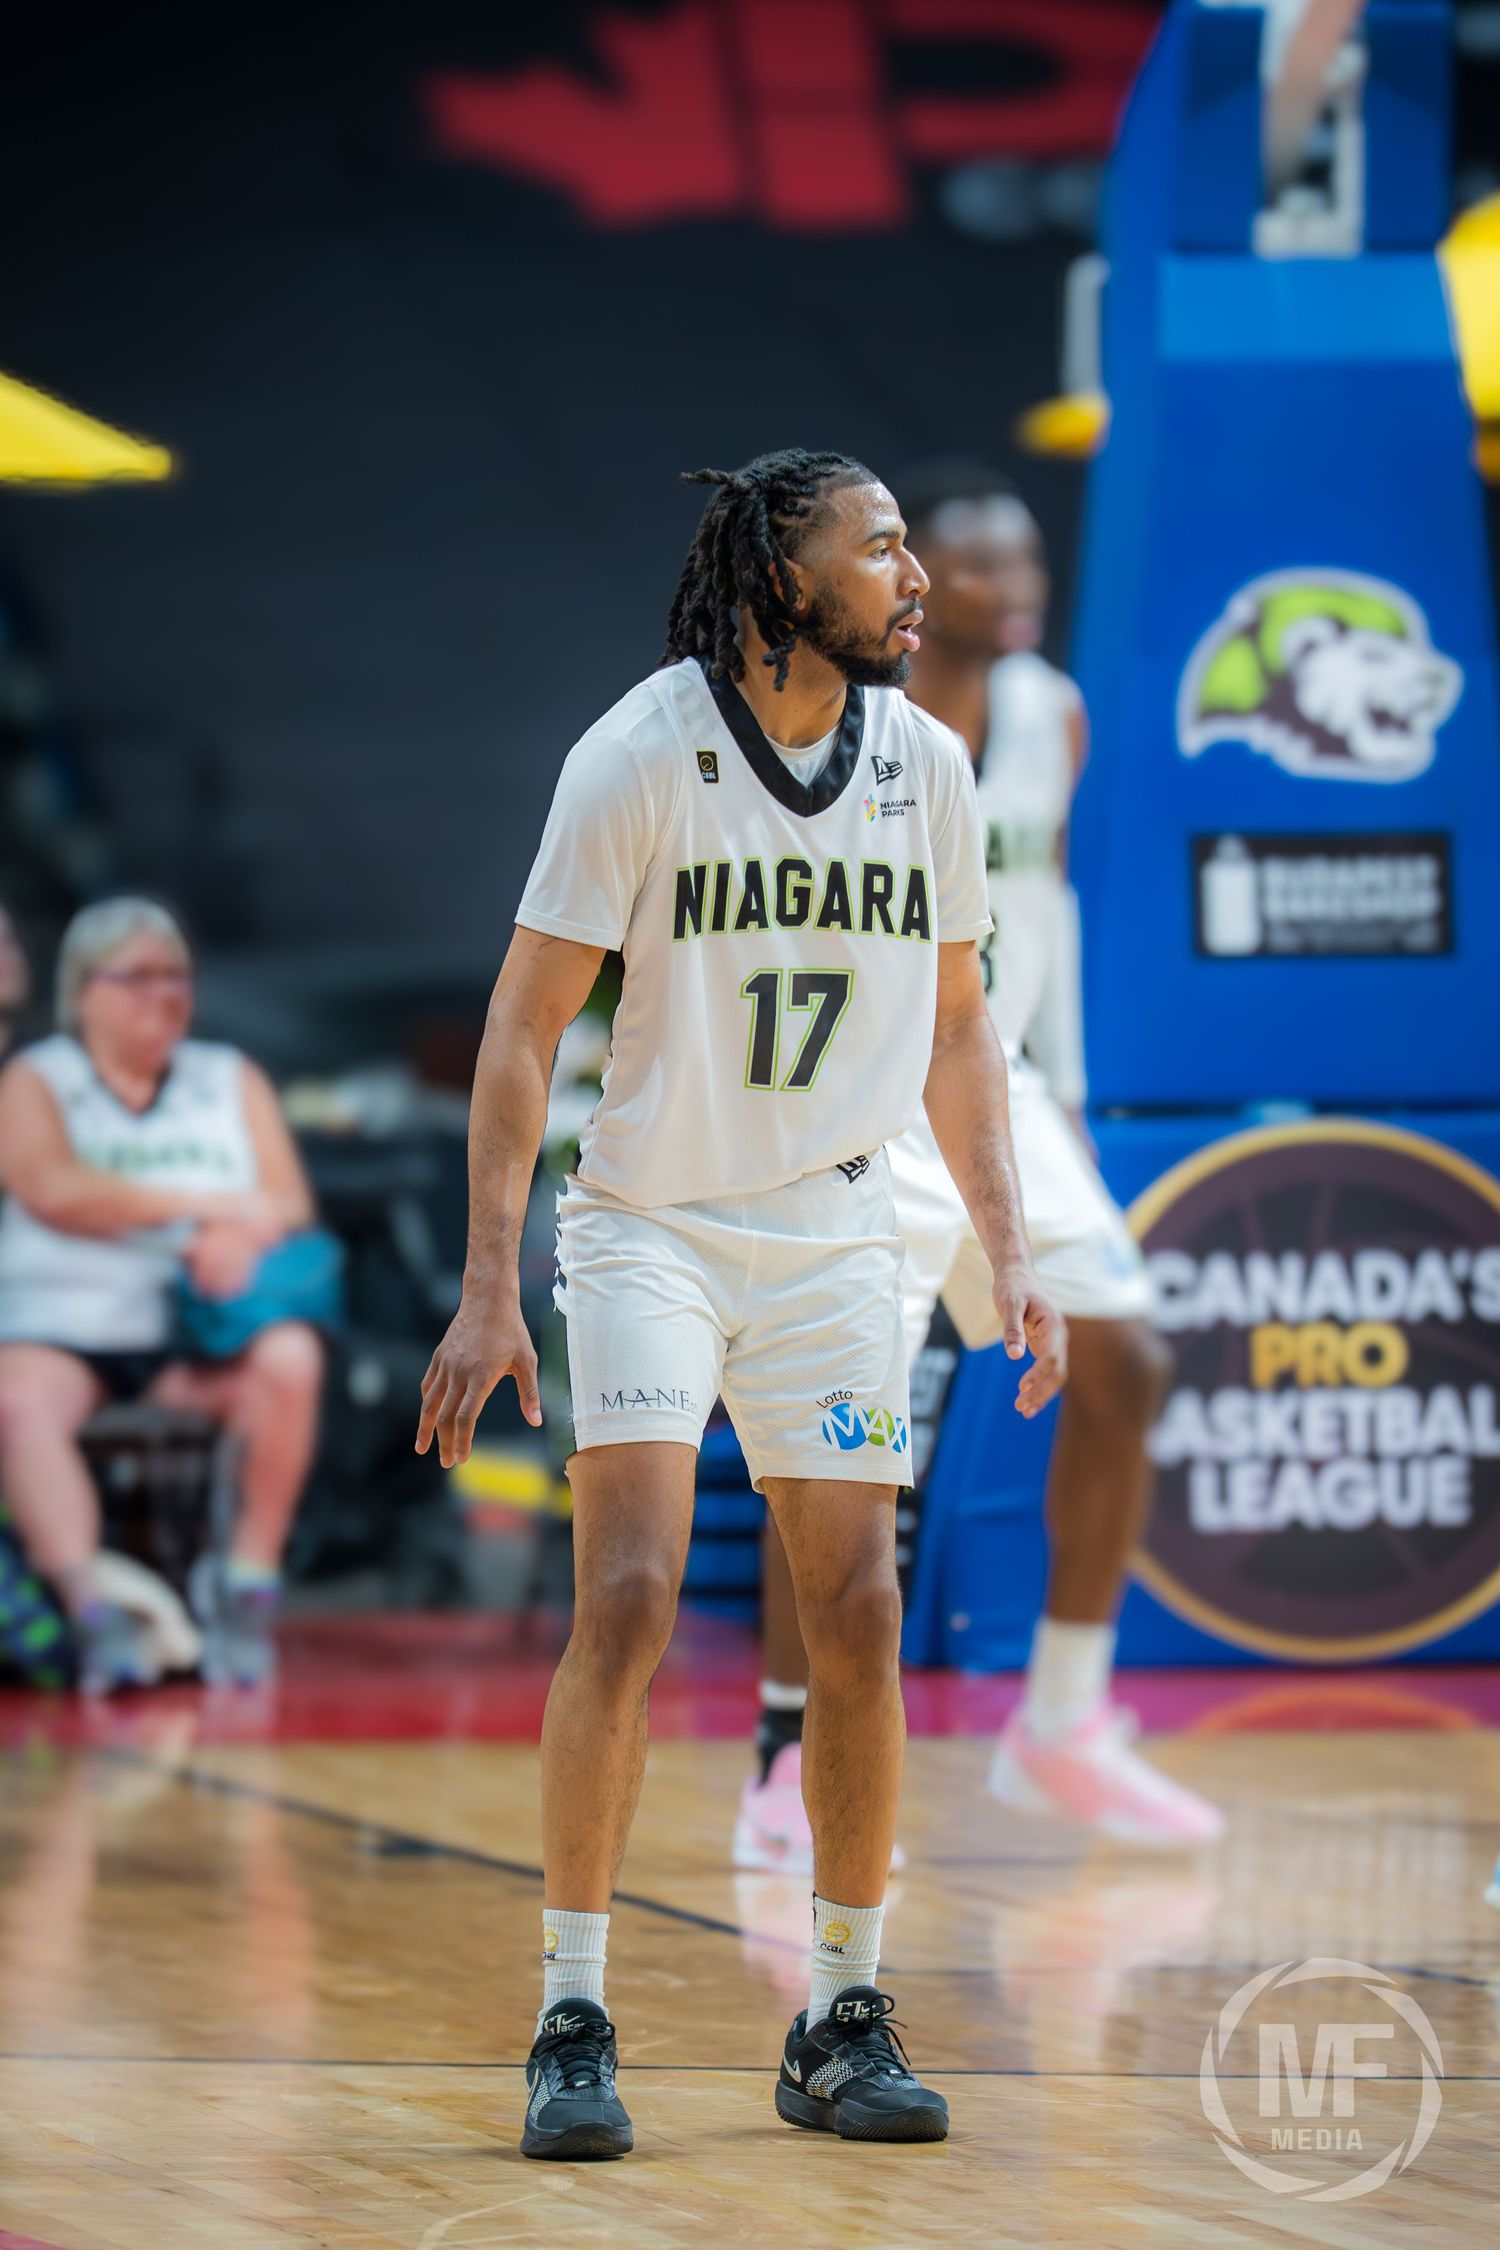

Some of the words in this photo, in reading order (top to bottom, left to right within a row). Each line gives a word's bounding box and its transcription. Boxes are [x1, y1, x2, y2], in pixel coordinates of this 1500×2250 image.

[880, 798, 917, 810] NIAGARA
[881, 808, 906, 819] PARKS
[672, 855, 933, 944] NIAGARA
[740, 968, 855, 1092] 17
[1250, 1322, 1410, 1388] PRO
[601, 1387, 690, 1412] MANE
[816, 1390, 854, 1409] Lotto
[822, 1402, 907, 1454] MAX
[1147, 1386, 1500, 1464] ASKETBAL
[1190, 1458, 1472, 1533] LEAGUE
